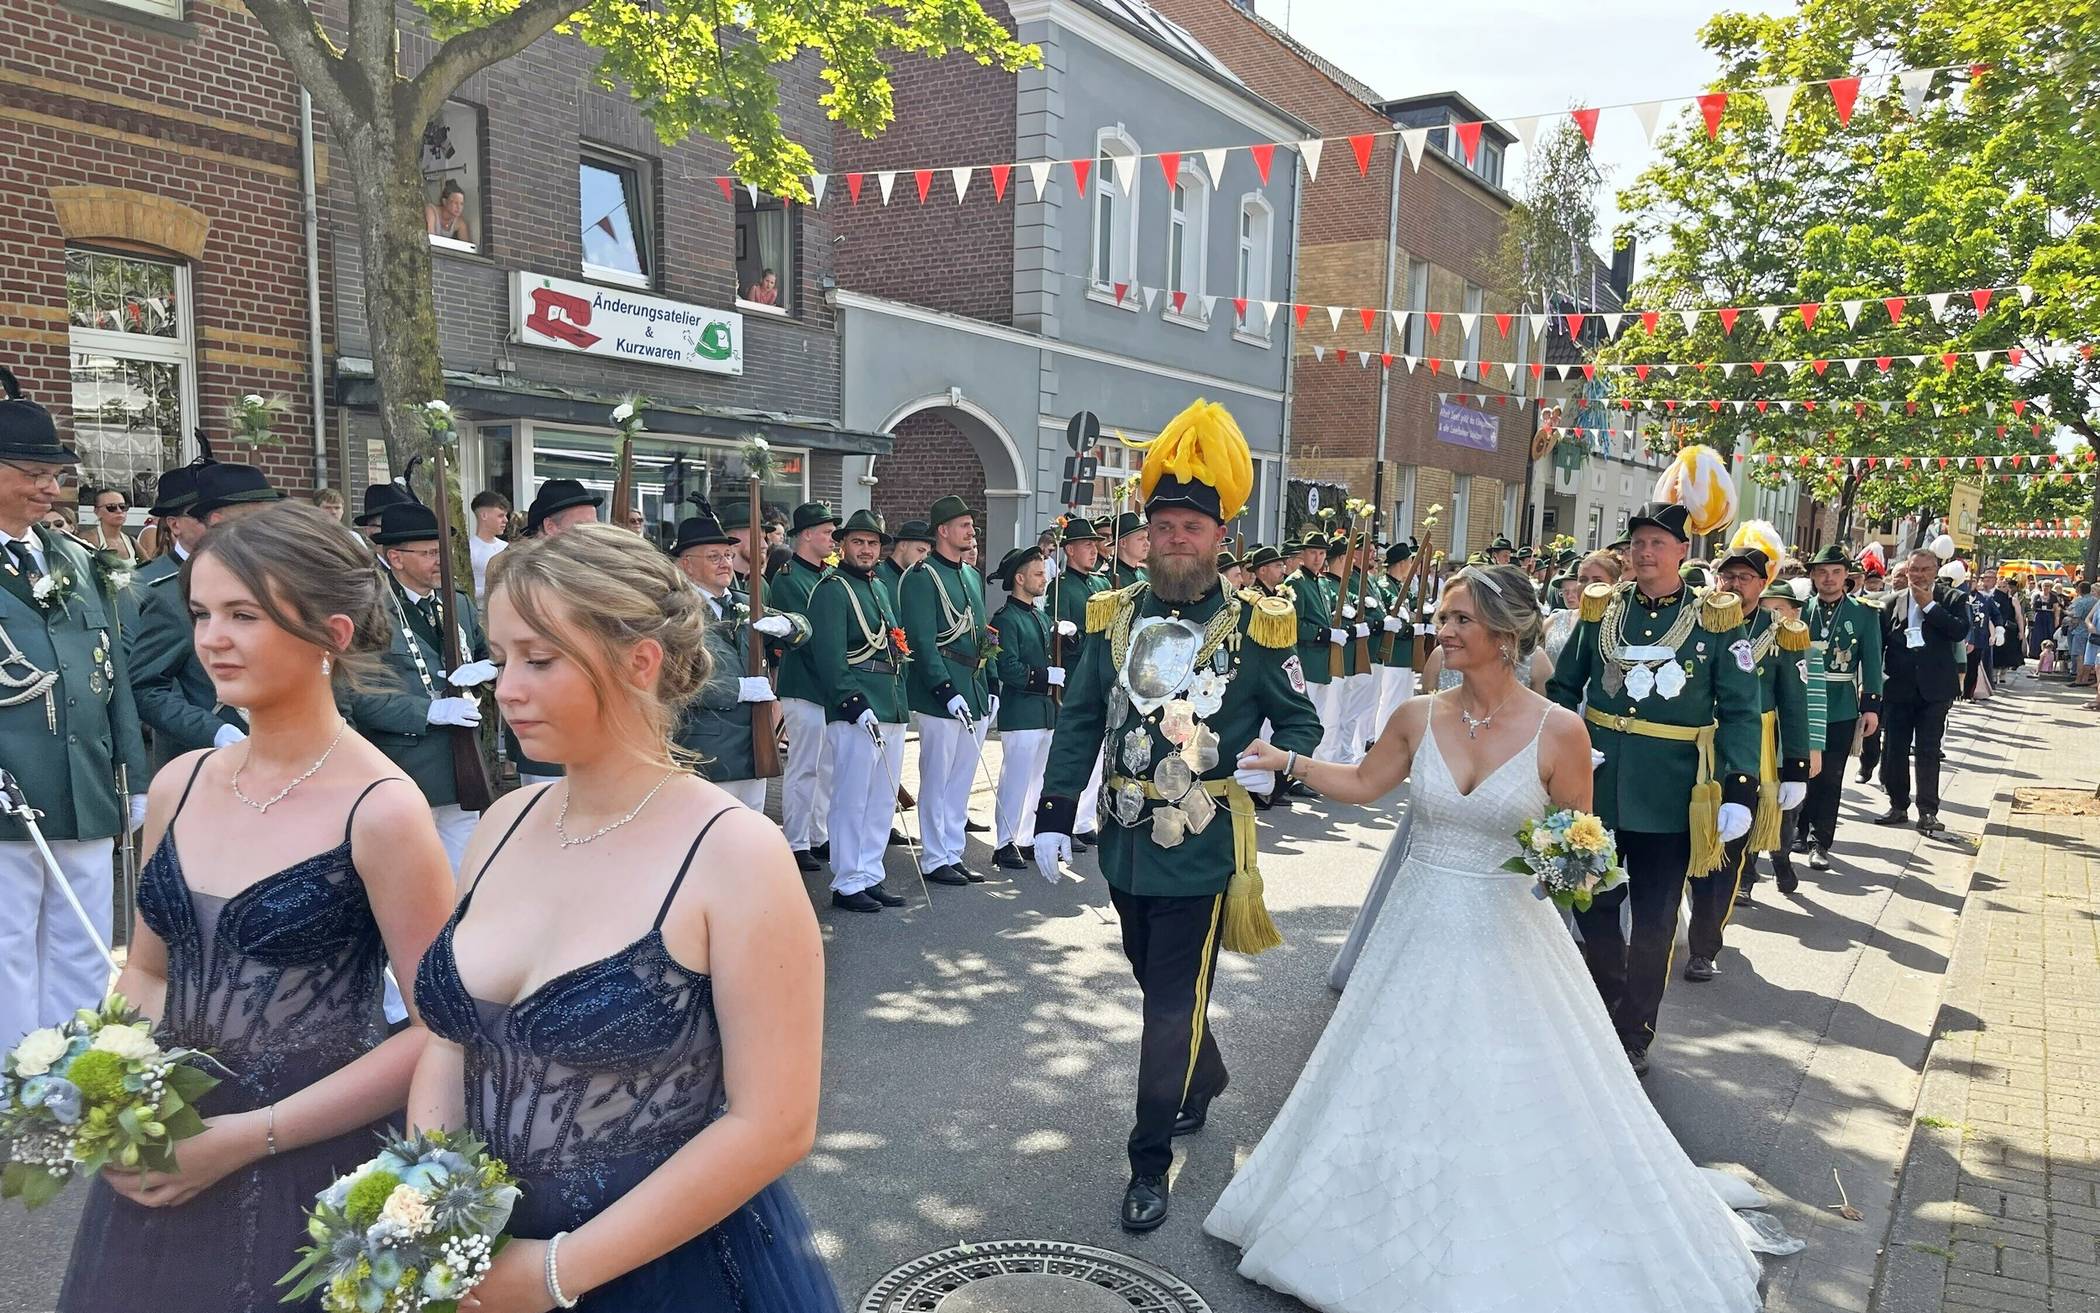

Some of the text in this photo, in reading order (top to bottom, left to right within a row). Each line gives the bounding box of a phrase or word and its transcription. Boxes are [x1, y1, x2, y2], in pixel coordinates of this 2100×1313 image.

[593, 292, 701, 326] Änderungsatelier
[645, 326, 654, 338] &
[616, 338, 681, 361] Kurzwaren
